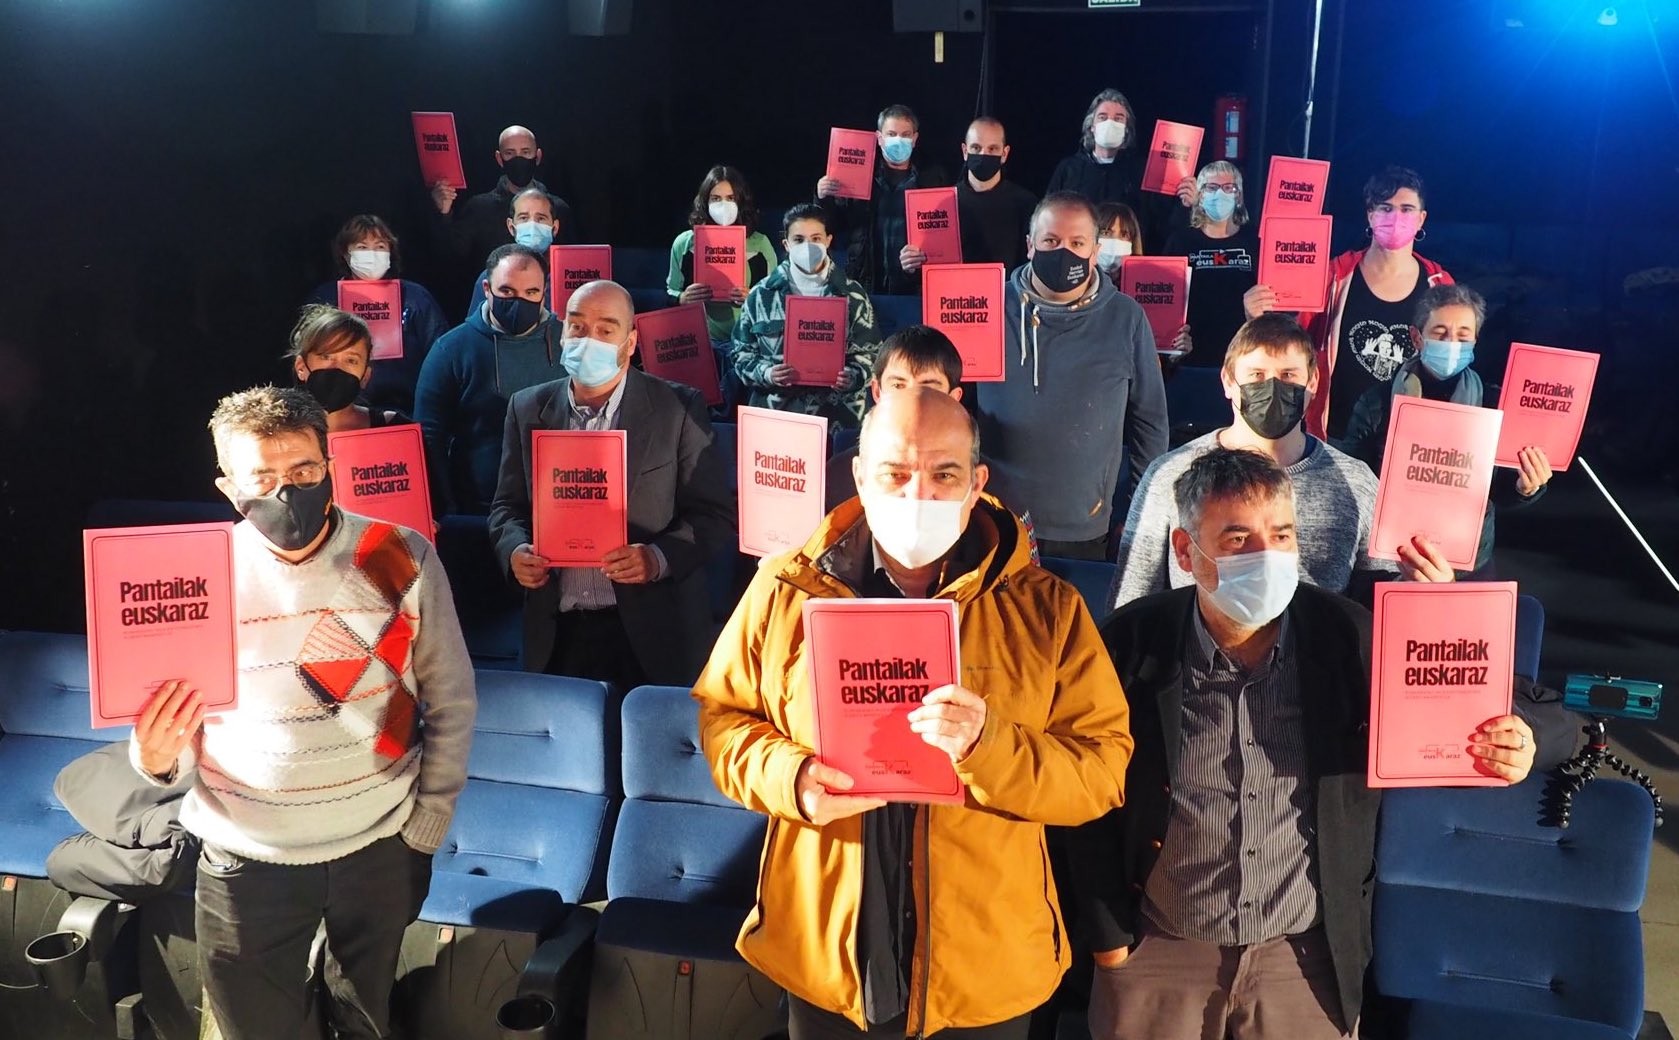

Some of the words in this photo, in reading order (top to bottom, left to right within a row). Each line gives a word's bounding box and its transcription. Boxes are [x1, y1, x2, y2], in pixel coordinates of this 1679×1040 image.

[839, 147, 866, 157] Pantailak
[838, 156, 865, 165] euskaraz
[1280, 180, 1314, 192] Pantailak
[1279, 190, 1312, 202] euskaraz
[917, 210, 948, 221] Pantailak
[917, 220, 949, 229] euskaraz
[705, 246, 736, 255] Pantailak
[1275, 241, 1317, 253] Pantailak
[705, 255, 736, 264] euskaraz
[1274, 252, 1316, 265] euskaraz
[564, 268, 601, 279] Pantailak
[1135, 281, 1174, 293] Pantailak
[352, 301, 389, 311] Pantailak
[940, 296, 989, 310] Pantailak
[940, 310, 989, 323] euskaraz
[798, 319, 835, 331] Pantailak
[798, 330, 834, 342] euskaraz
[1522, 379, 1574, 399] Pantailak
[1519, 394, 1572, 413] euskaraz
[754, 450, 806, 475] Pantailak
[1409, 443, 1474, 470] Pantailak
[351, 461, 409, 481] Pantailak
[552, 467, 608, 484] Pantailak
[1406, 464, 1471, 489] euskaraz
[353, 478, 410, 497] euskaraz
[754, 470, 806, 493] euskaraz
[552, 484, 609, 500] euskaraz
[119, 576, 208, 603] Pantailak
[121, 602, 209, 626] euskaraz
[1405, 638, 1489, 662] Pantailak
[838, 657, 929, 681] Pantailak
[1404, 664, 1489, 686] euskaraz
[841, 682, 930, 705] euskaraz
